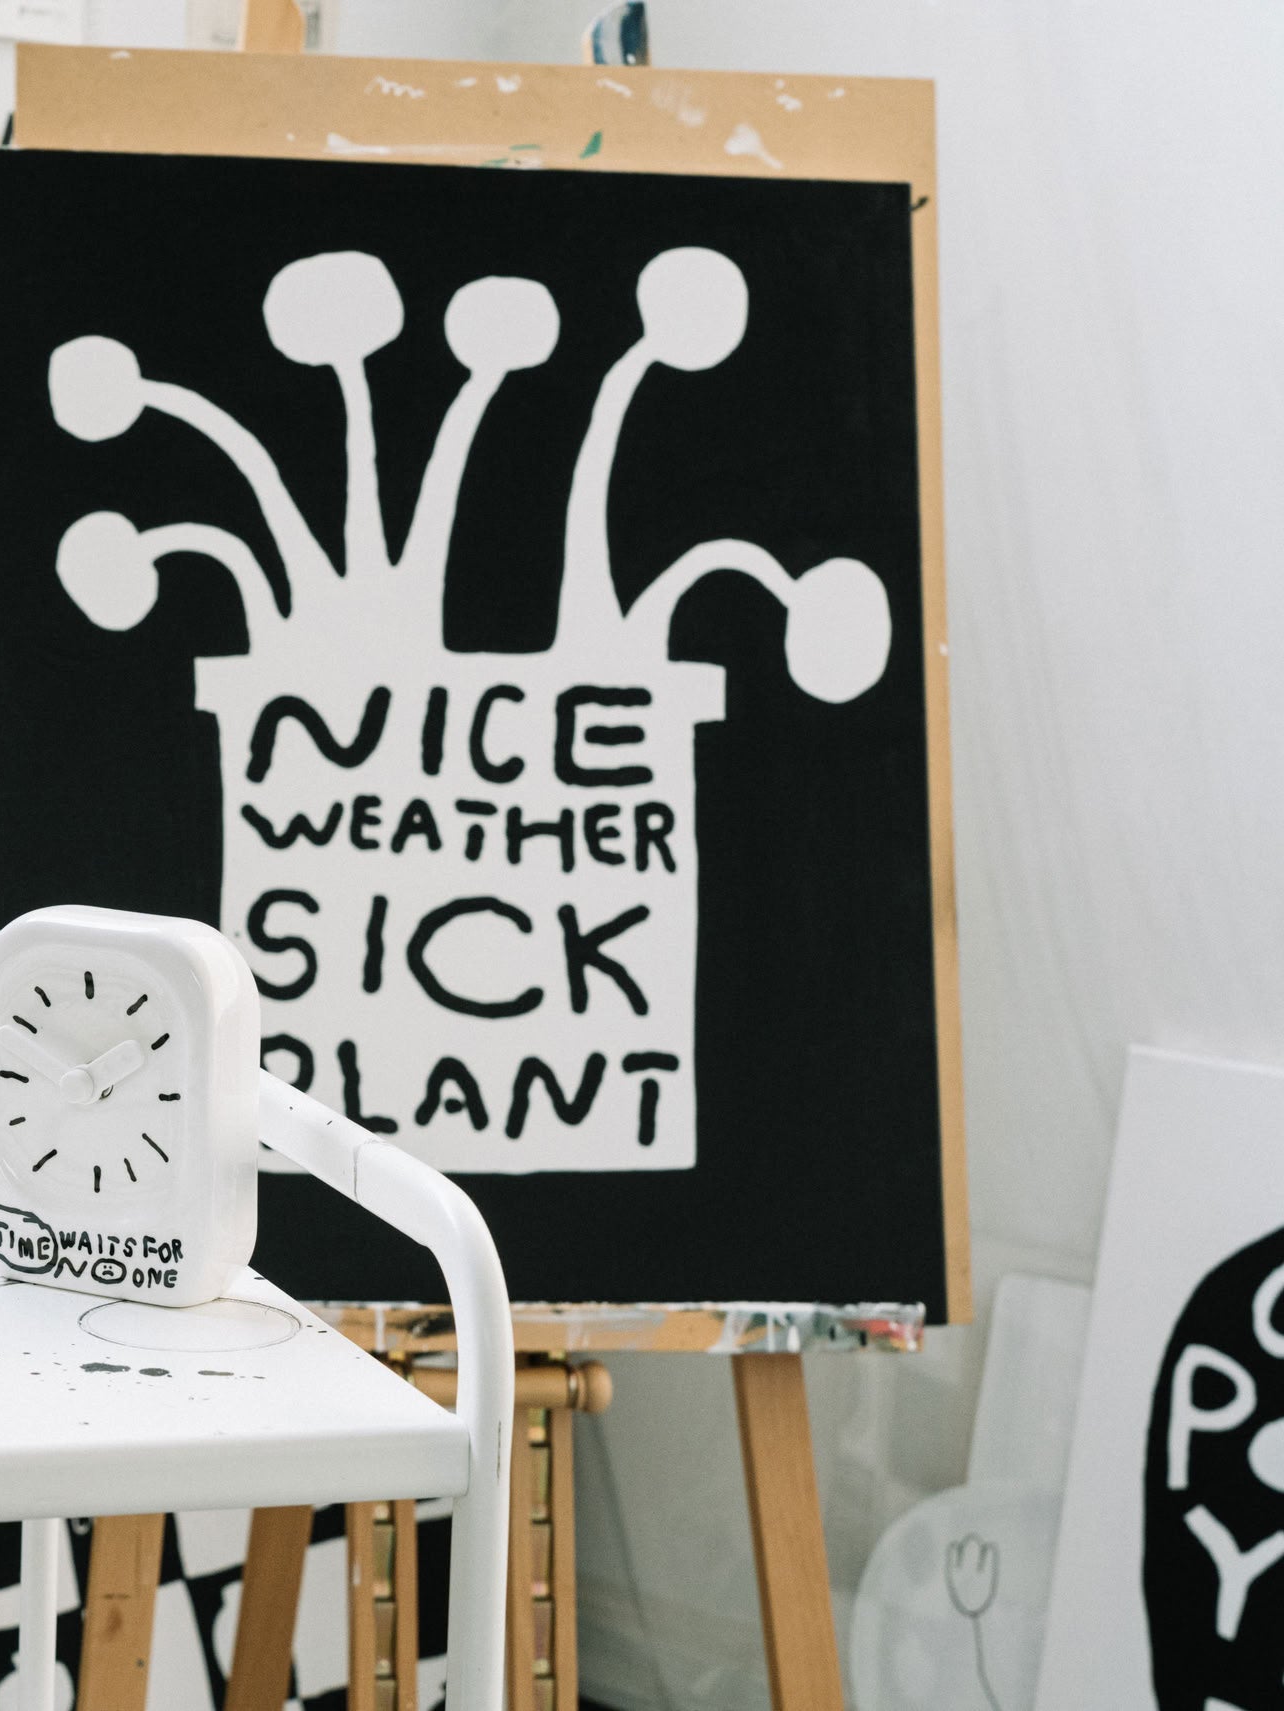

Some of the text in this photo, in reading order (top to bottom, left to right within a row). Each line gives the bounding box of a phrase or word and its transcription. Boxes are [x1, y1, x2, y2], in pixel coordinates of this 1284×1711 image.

[247, 684, 653, 786] NICE
[241, 795, 676, 873] WEATHER
[247, 889, 649, 1018] SICK
[59, 1231, 137, 1258] WAITS
[143, 1236, 184, 1263] FOR
[132, 1268, 178, 1289] ONE
